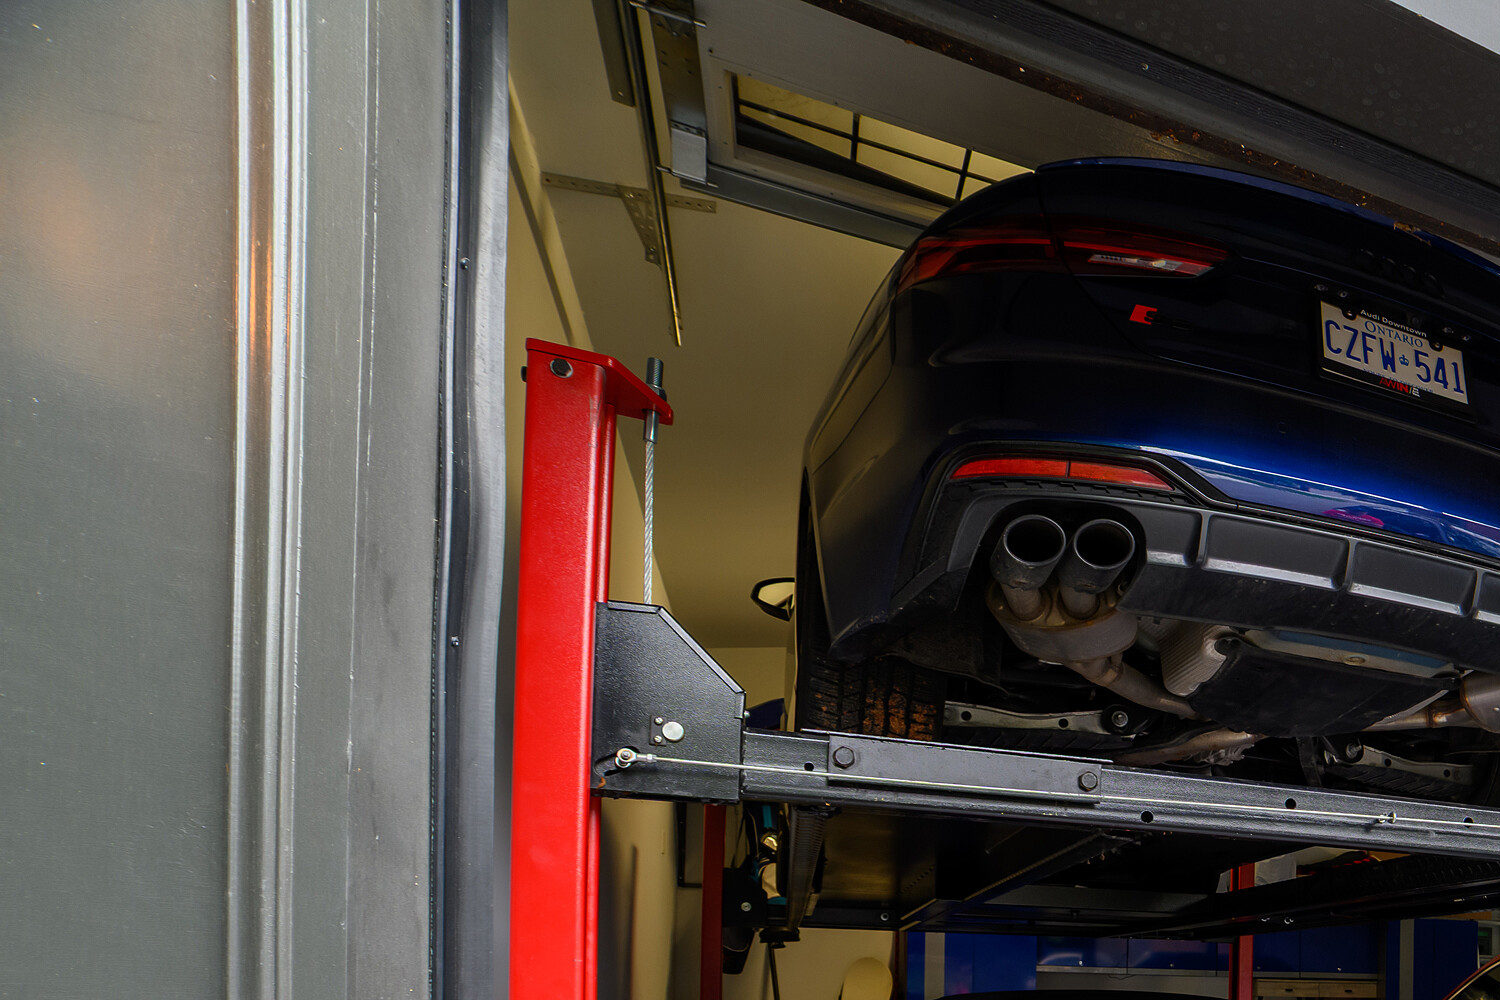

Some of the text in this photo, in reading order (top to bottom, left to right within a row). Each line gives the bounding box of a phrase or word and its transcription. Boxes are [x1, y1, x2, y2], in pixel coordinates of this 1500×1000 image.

[1360, 309, 1427, 338] Audi Downtown
[1364, 320, 1423, 348] ONTARIO
[1324, 319, 1396, 373] CZFW
[1414, 349, 1465, 394] 541
